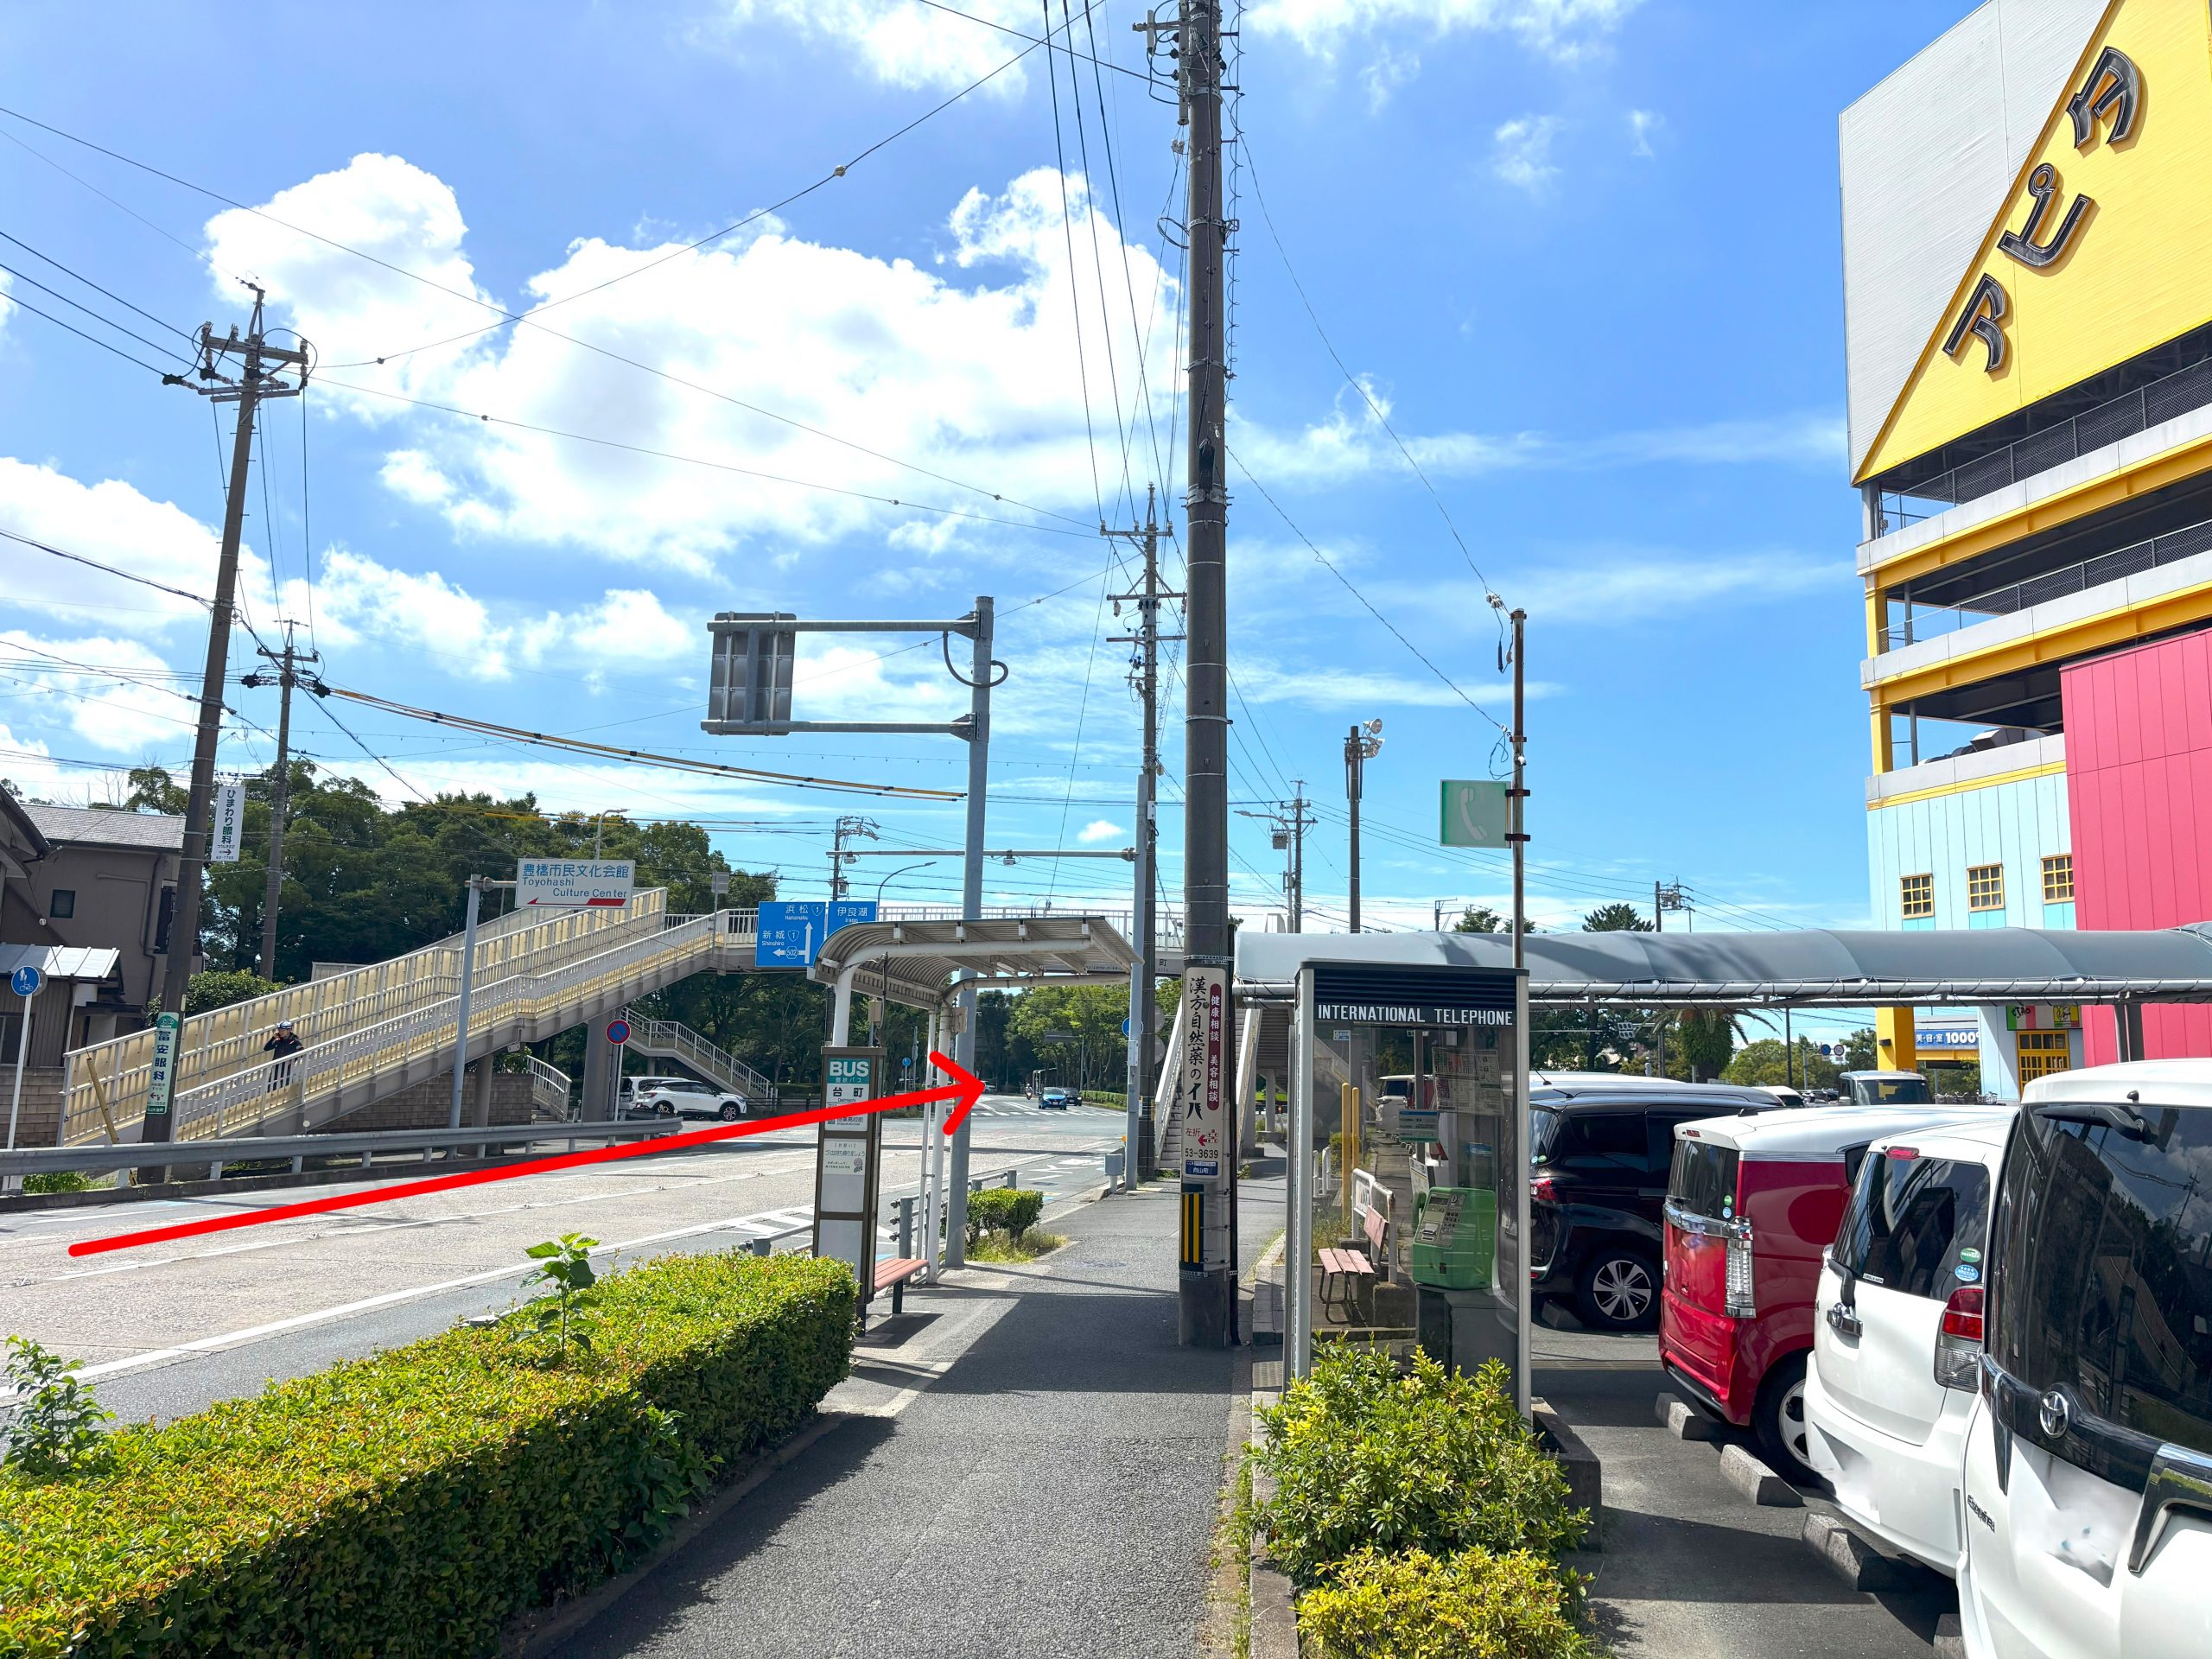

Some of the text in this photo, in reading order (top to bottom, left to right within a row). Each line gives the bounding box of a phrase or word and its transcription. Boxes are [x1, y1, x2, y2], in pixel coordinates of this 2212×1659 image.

[1942, 46, 2139, 373] アピタ
[221, 789, 237, 844] ひまわり眼科
[522, 863, 629, 878] 豊橋市民文化会館
[523, 877, 575, 887] Toyohashi
[553, 887, 627, 898] Culture Center
[785, 904, 809, 914] 浜松
[837, 906, 868, 917] 伊良湖
[762, 930, 785, 940] 新城
[1318, 1003, 1514, 1026] INTERNATIONAL TELEPHONE
[1208, 995, 1221, 1103] 健康相談 美容相談
[153, 1031, 171, 1081] 富安眼科
[830, 1060, 869, 1077] BUS
[832, 1086, 864, 1098] 台町
[1185, 1128, 1201, 1137] 左折
[1185, 1147, 1219, 1159] 53-3639
